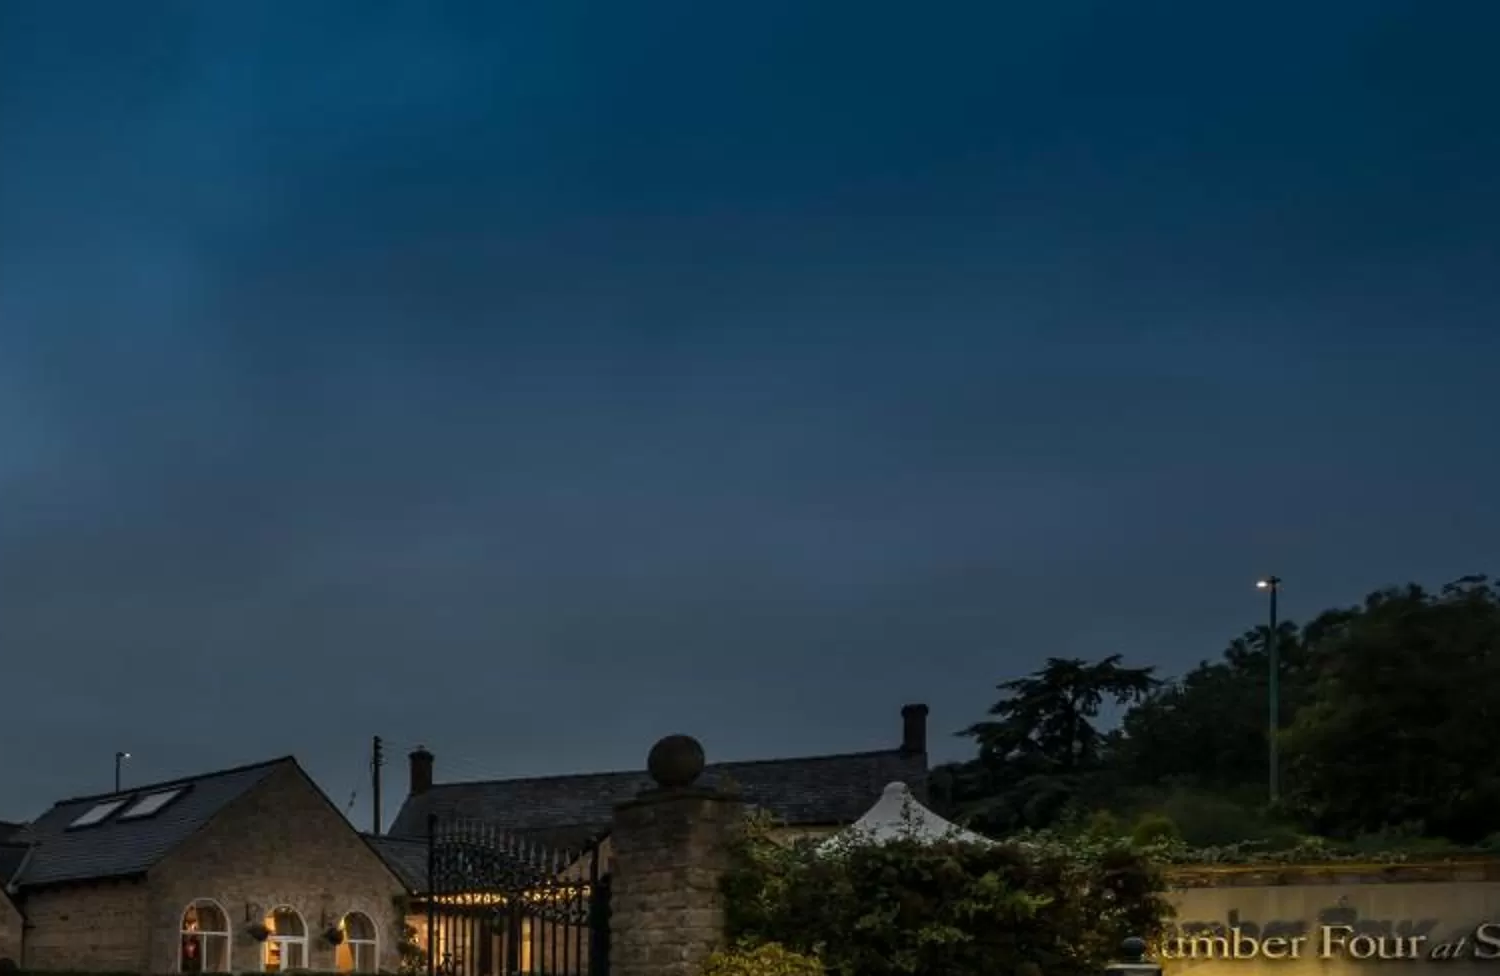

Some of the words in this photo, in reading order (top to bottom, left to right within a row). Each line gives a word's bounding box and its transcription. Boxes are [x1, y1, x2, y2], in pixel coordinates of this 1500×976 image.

[1161, 926, 1307, 960] umber
[1320, 924, 1427, 960] Four
[1431, 937, 1467, 960] at
